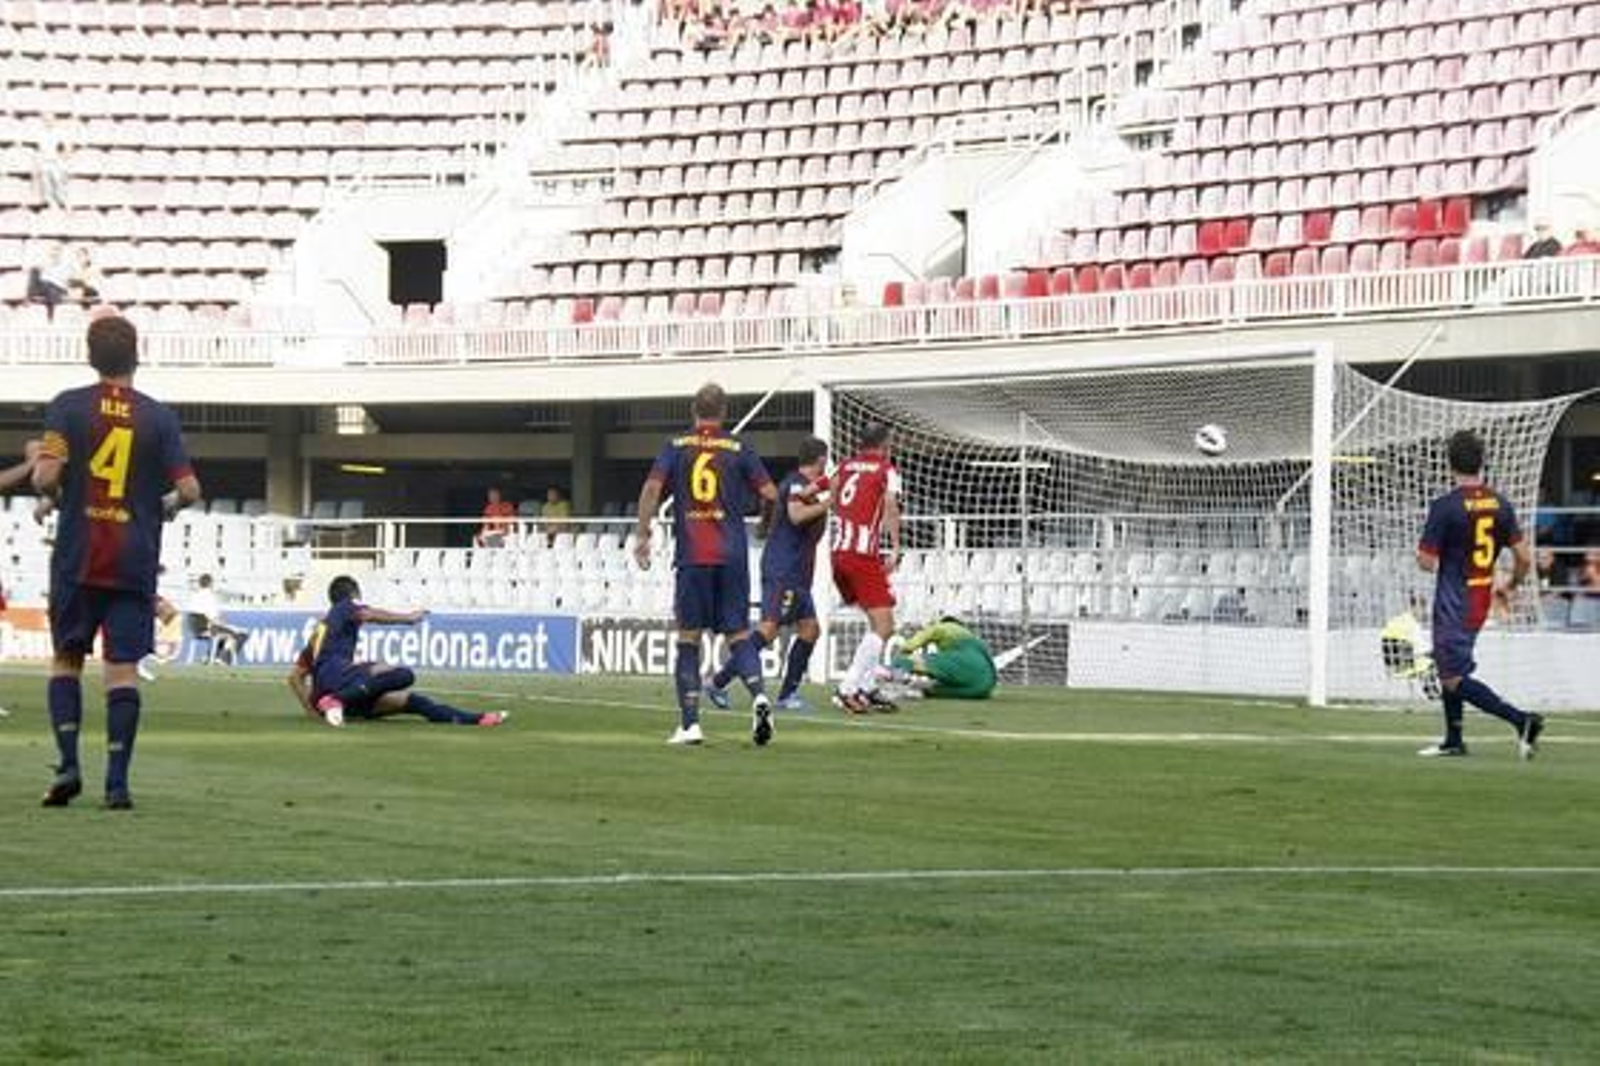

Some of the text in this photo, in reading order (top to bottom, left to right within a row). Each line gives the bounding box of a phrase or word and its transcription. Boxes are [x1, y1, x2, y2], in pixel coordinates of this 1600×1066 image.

[89, 426, 133, 498] 4
[692, 452, 717, 502] 6
[841, 472, 860, 506] 6
[1473, 517, 1494, 567] 5
